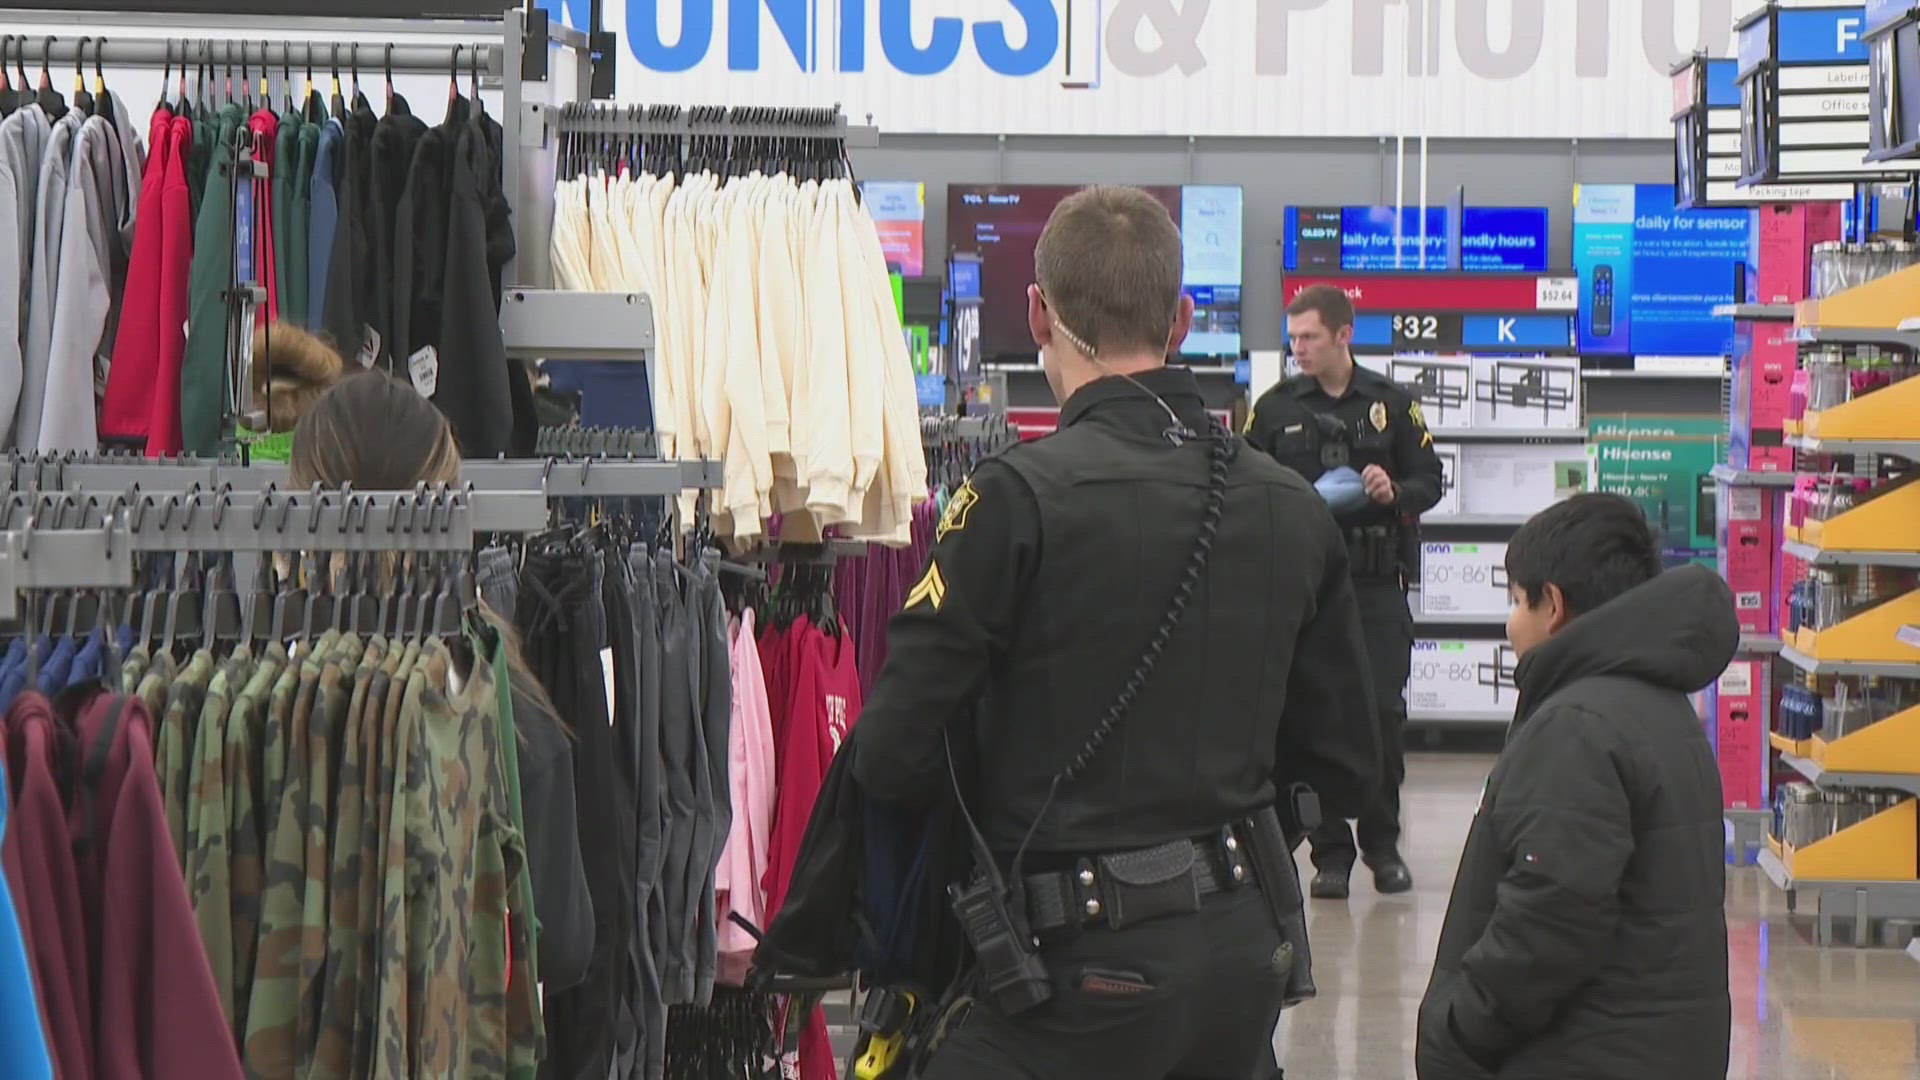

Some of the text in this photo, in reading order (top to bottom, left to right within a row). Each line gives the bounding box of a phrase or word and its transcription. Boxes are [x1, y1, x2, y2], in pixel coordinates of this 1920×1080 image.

[1837, 18, 1860, 54] F
[1827, 72, 1858, 82] Label
[1821, 99, 1859, 111] Office
[1749, 187, 1811, 197] Packing tape
[1636, 215, 1669, 232] daily
[1673, 215, 1694, 230] for
[1372, 233, 1391, 246] for
[1499, 233, 1536, 247] hours
[1543, 289, 1573, 301] $52.64
[1393, 315, 1438, 340] $32
[1498, 318, 1516, 343] K
[1603, 447, 1673, 461] Hisense
[1426, 543, 1451, 555] onn
